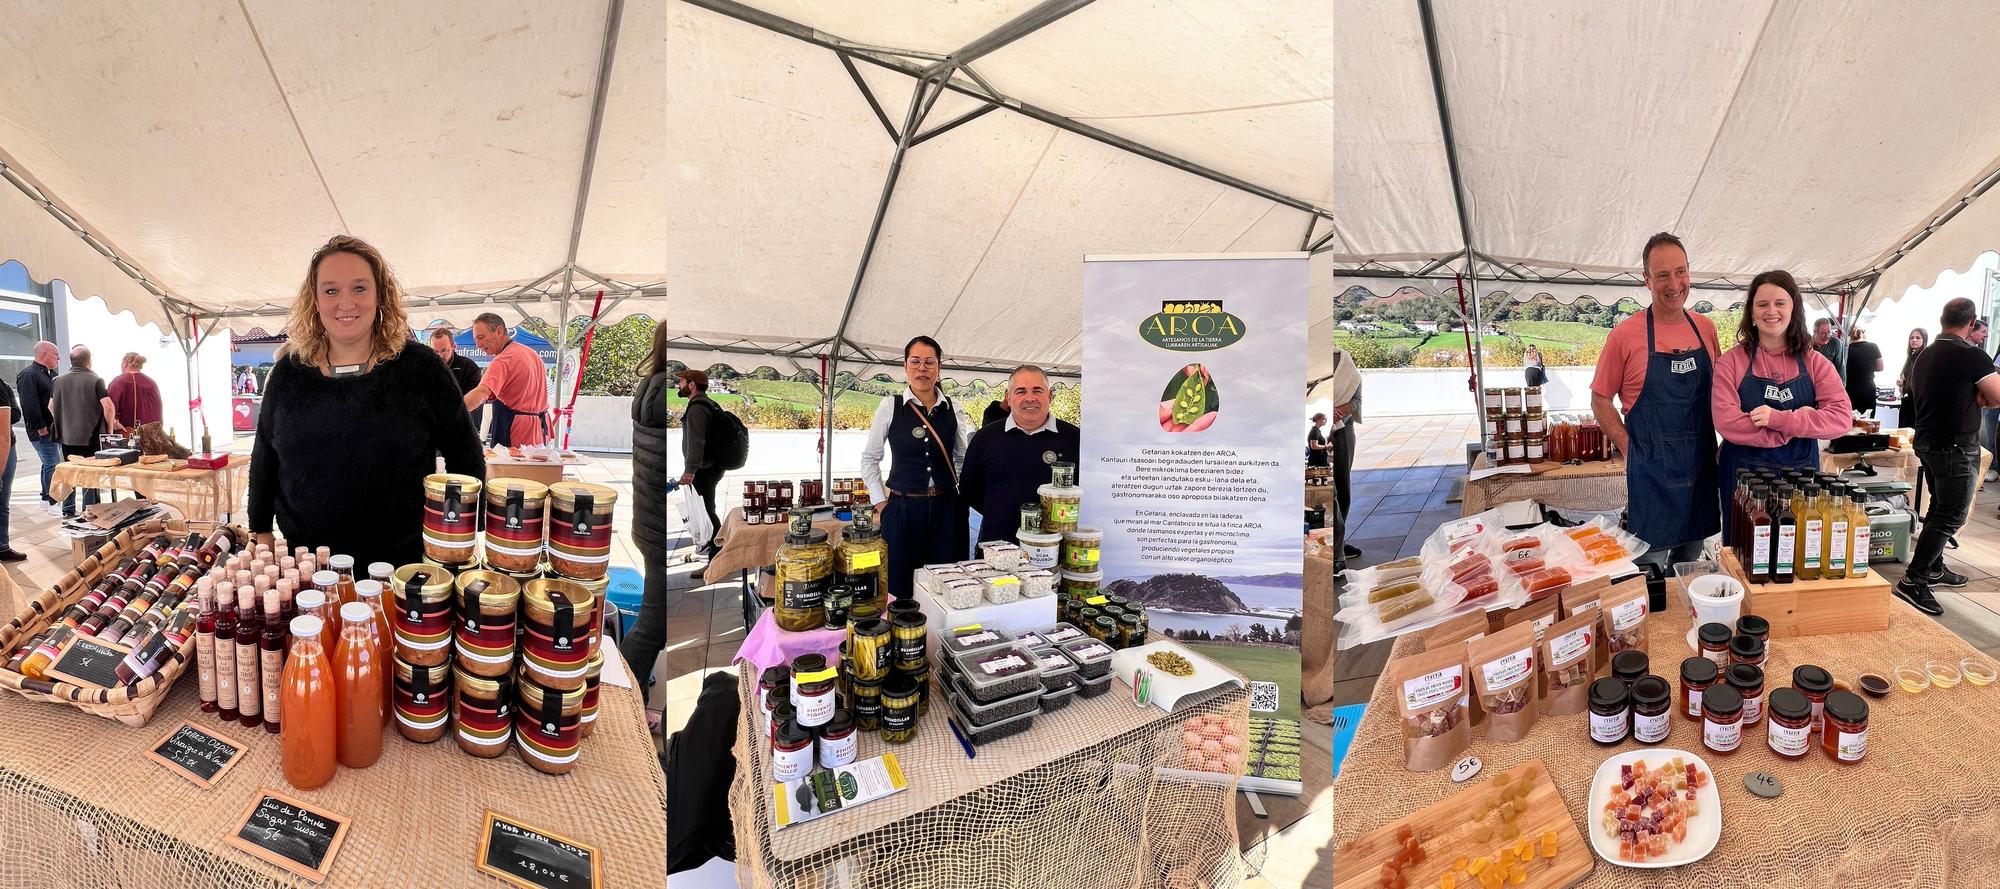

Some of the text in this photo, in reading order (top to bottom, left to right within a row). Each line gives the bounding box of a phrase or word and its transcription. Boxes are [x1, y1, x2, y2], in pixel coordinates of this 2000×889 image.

[1147, 316, 1238, 335] AROA
[1518, 550, 1530, 559] 6€
[796, 591, 822, 599] GUINDILL
[1458, 758, 1477, 773] 5€
[1756, 774, 1774, 786] 4€
[280, 806, 294, 816] de
[264, 828, 280, 840] 5€
